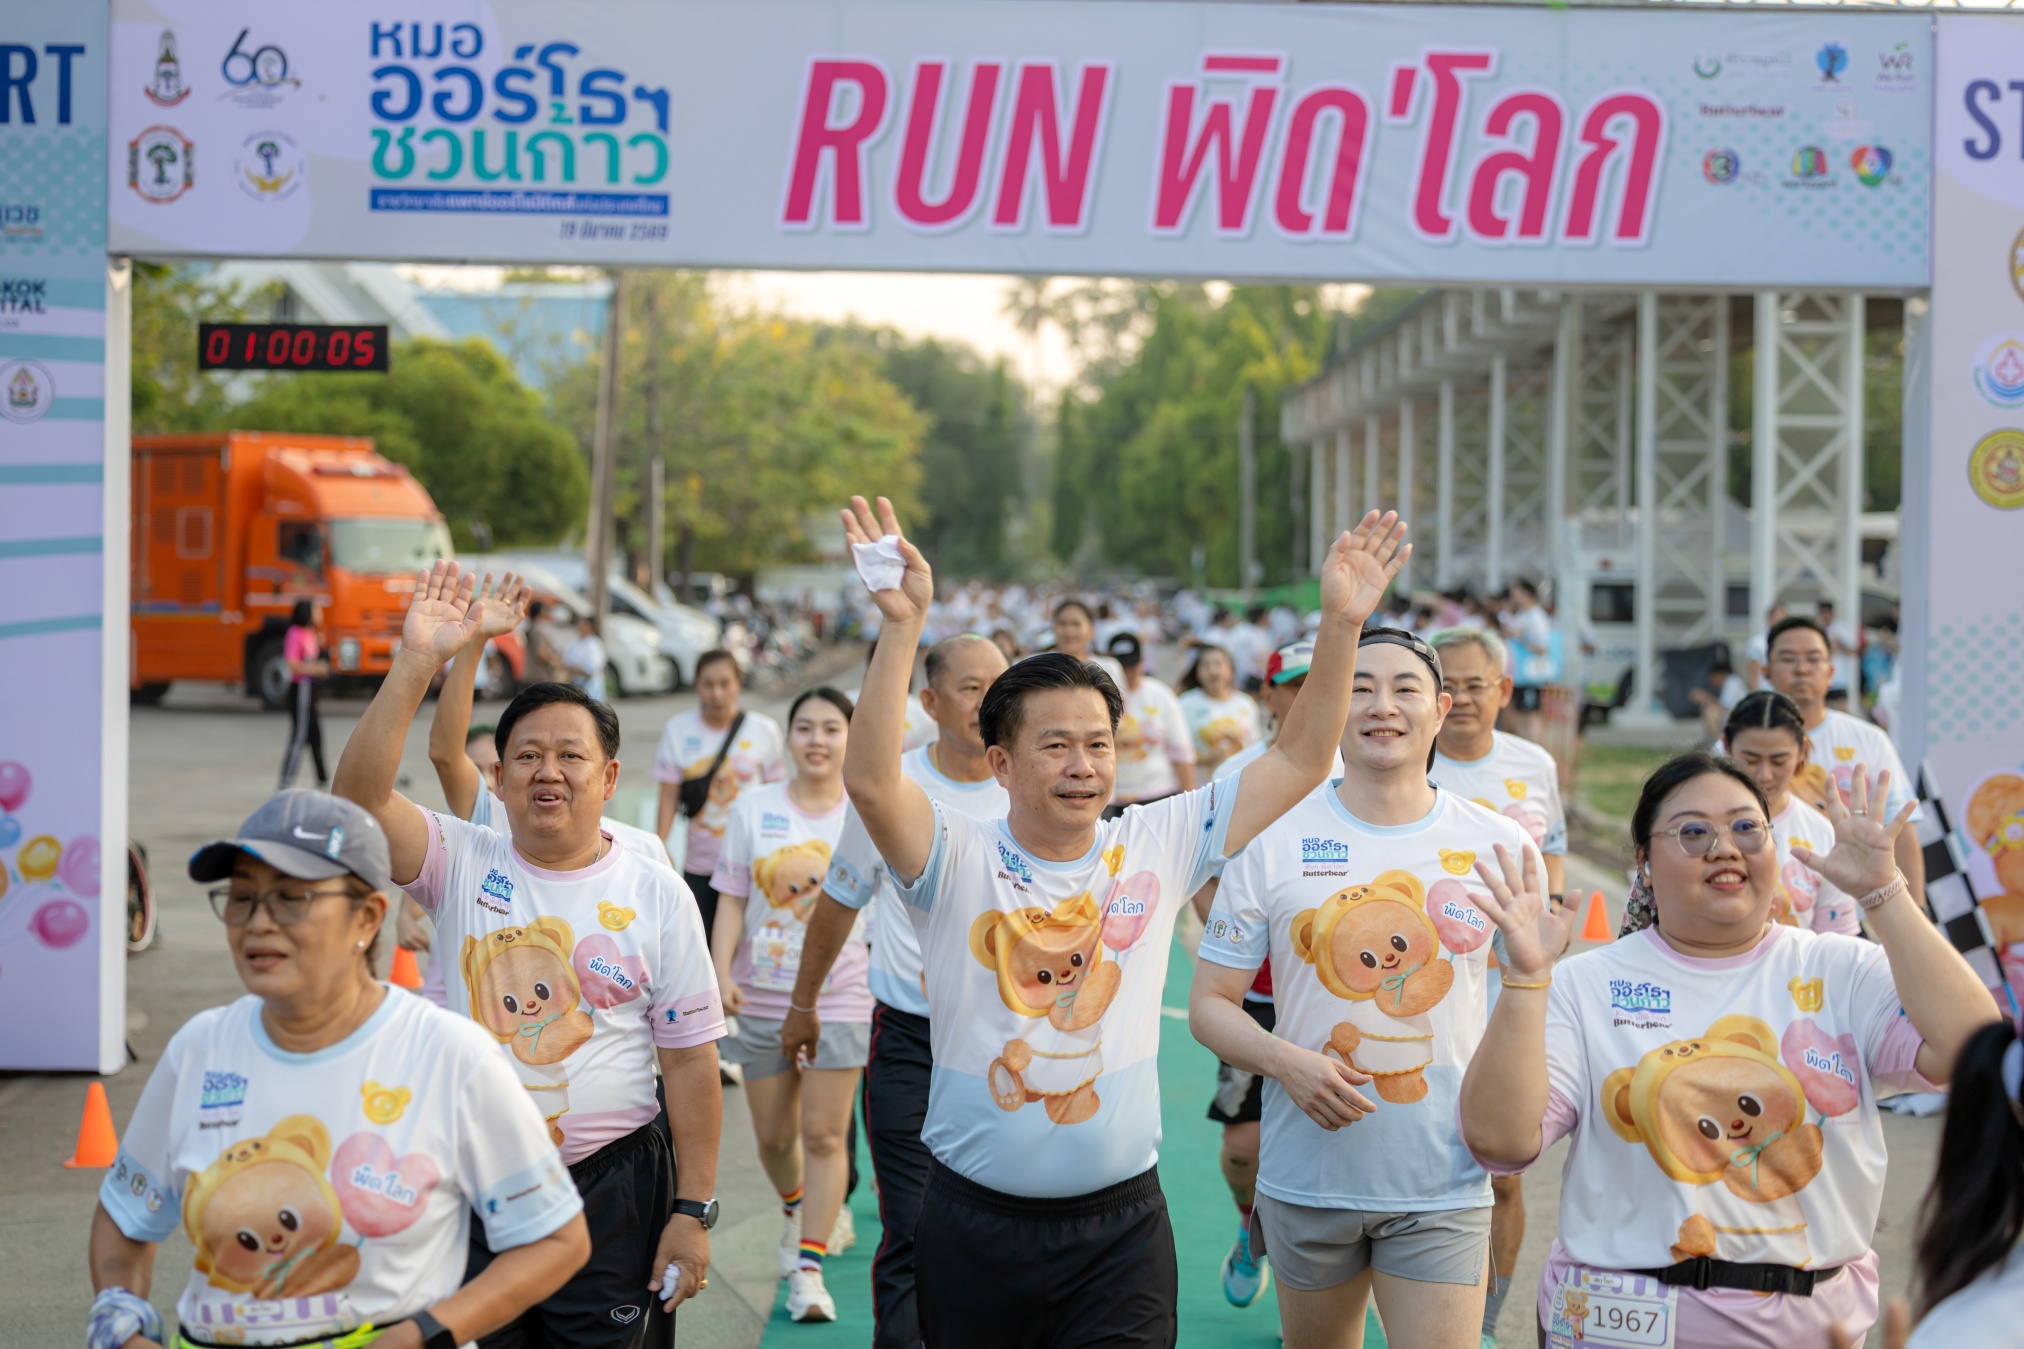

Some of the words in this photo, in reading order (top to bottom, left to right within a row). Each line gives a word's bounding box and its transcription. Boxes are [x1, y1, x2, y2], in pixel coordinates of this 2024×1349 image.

[222, 27, 288, 89] 60
[371, 22, 483, 59] หมอ
[371, 101, 669, 186] ชวนก้าว
[784, 60, 1108, 226] RUN
[206, 329, 376, 366] 01:00:05
[1593, 1305, 1659, 1334] 1967
